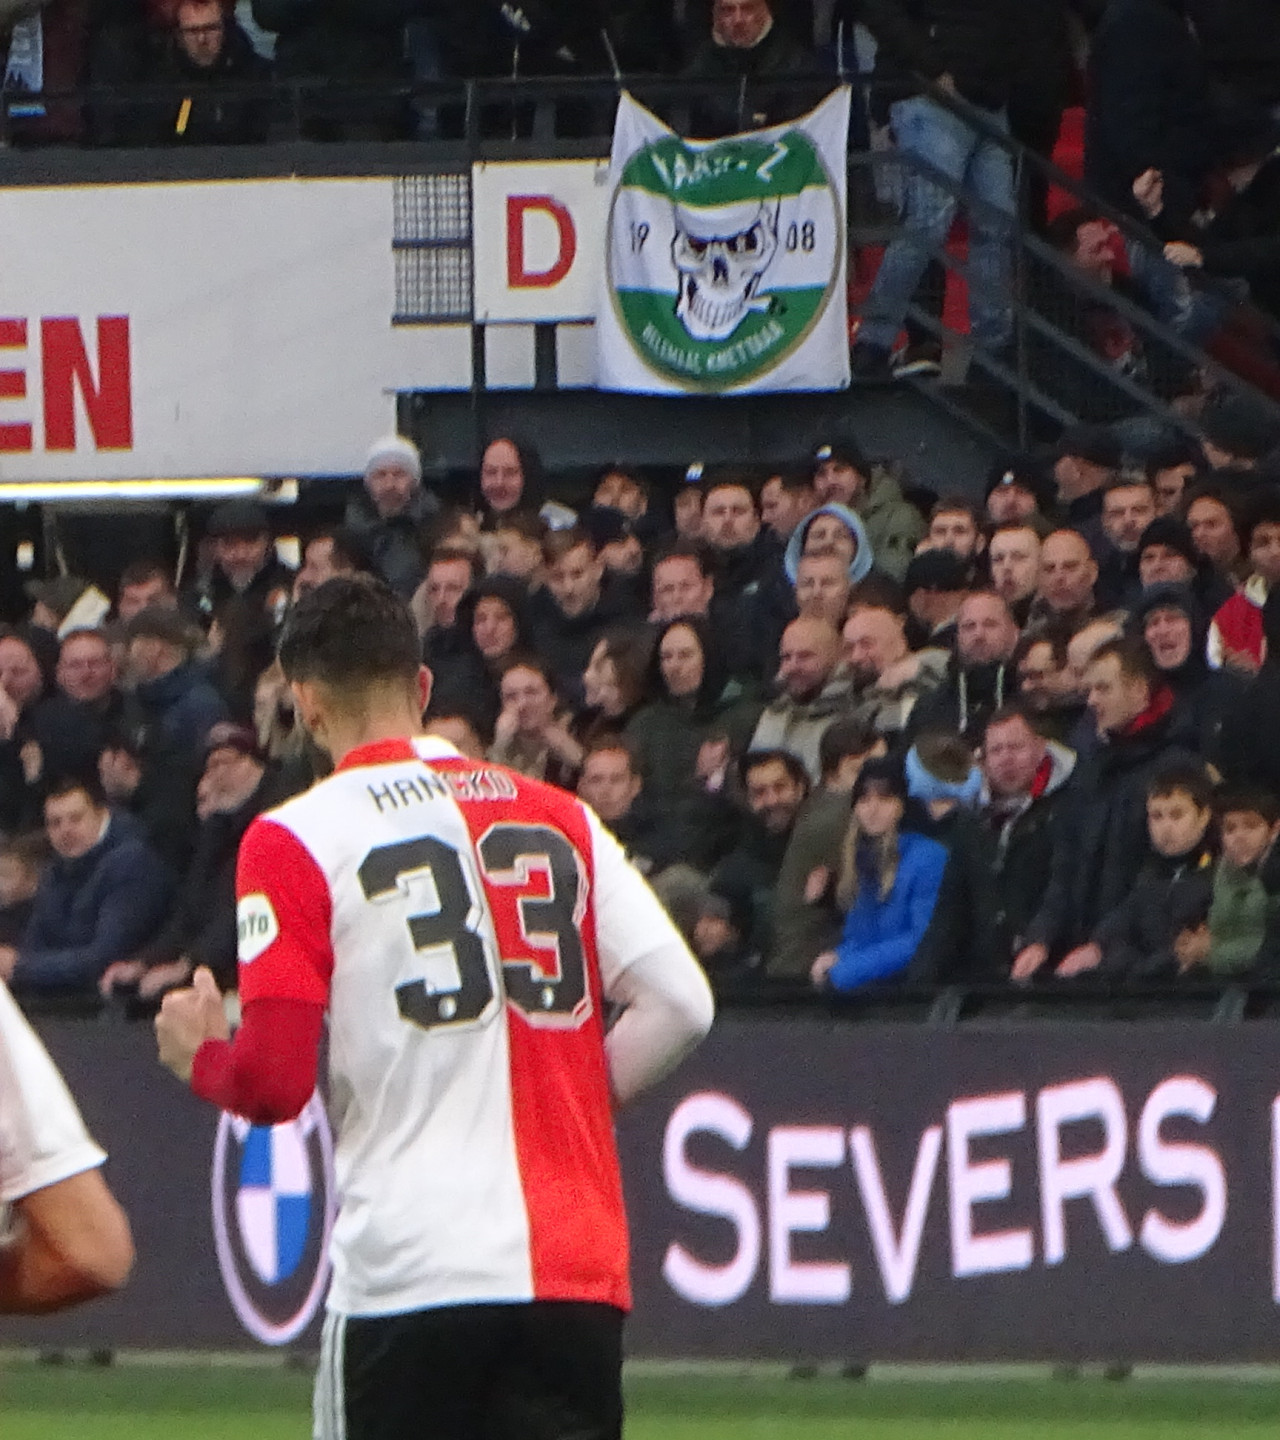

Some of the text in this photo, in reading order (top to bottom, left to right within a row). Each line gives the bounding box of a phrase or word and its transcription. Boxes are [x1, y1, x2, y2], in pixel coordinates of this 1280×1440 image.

[506, 194, 577, 289] D
[787, 220, 816, 252] 08
[357, 822, 595, 1033] 33
